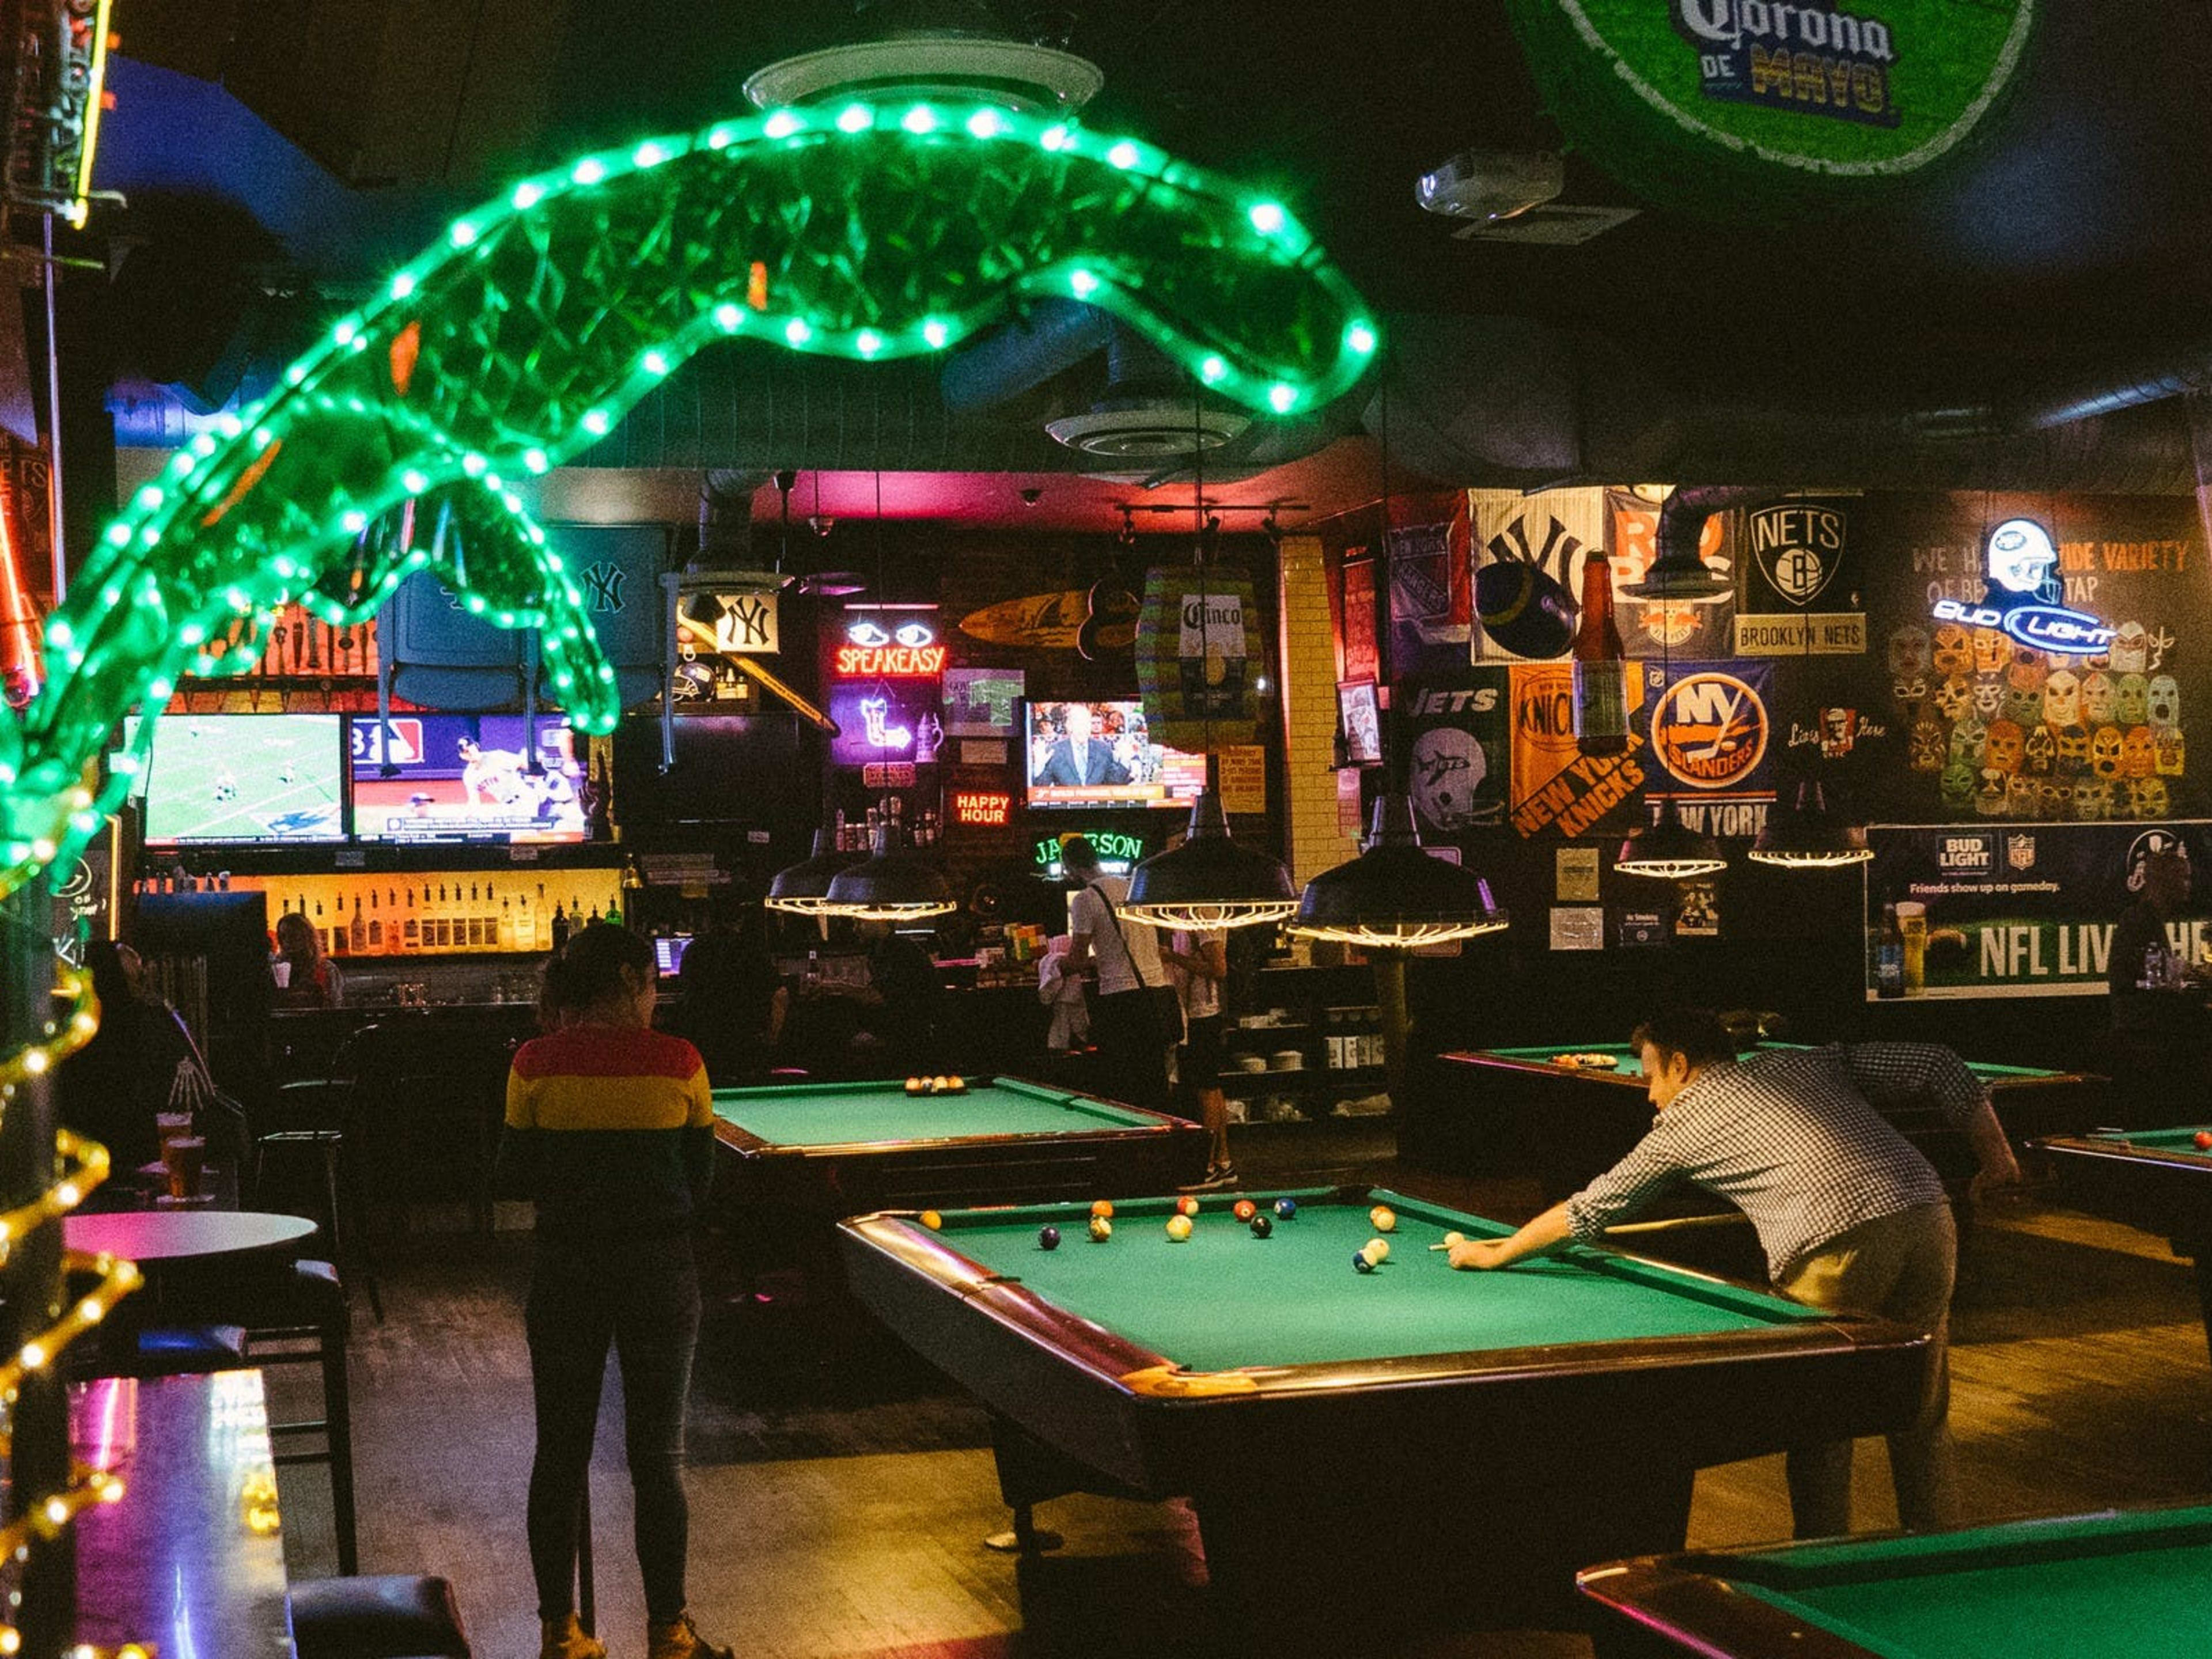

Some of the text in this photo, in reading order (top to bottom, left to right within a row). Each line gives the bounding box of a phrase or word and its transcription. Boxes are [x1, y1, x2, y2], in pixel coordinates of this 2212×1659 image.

[1680, 0, 1893, 61] Corona
[1700, 43, 1884, 113] DE MAYO
[1758, 509, 1840, 552] NETS
[2103, 540, 2190, 573] VARIETY
[2063, 576, 2099, 602] TAP
[1183, 603, 1240, 629] Cinco
[1933, 600, 2118, 645] BUD LIGHT
[1740, 625, 1861, 646] BROOKLYN NETS
[838, 646, 945, 673] SPEAKEASY
[1407, 688, 1498, 718] JETS
[1518, 692, 1574, 736] KNIC
[957, 795, 1010, 809] HAPPY
[1514, 777, 1575, 839] NEW
[1556, 759, 1645, 838] KNICKS
[961, 809, 1005, 823] HOUR
[1036, 832, 1143, 864] JASON
[1939, 851, 1990, 866] LIGHT
[1945, 838, 1983, 853] BUD
[1910, 882, 1950, 894] Friends
[1950, 882, 1978, 893] show
[1979, 884, 1994, 895] up
[1995, 884, 2009, 892] on
[1980, 925, 2048, 977] NFL
[2058, 923, 2119, 975] LIV
